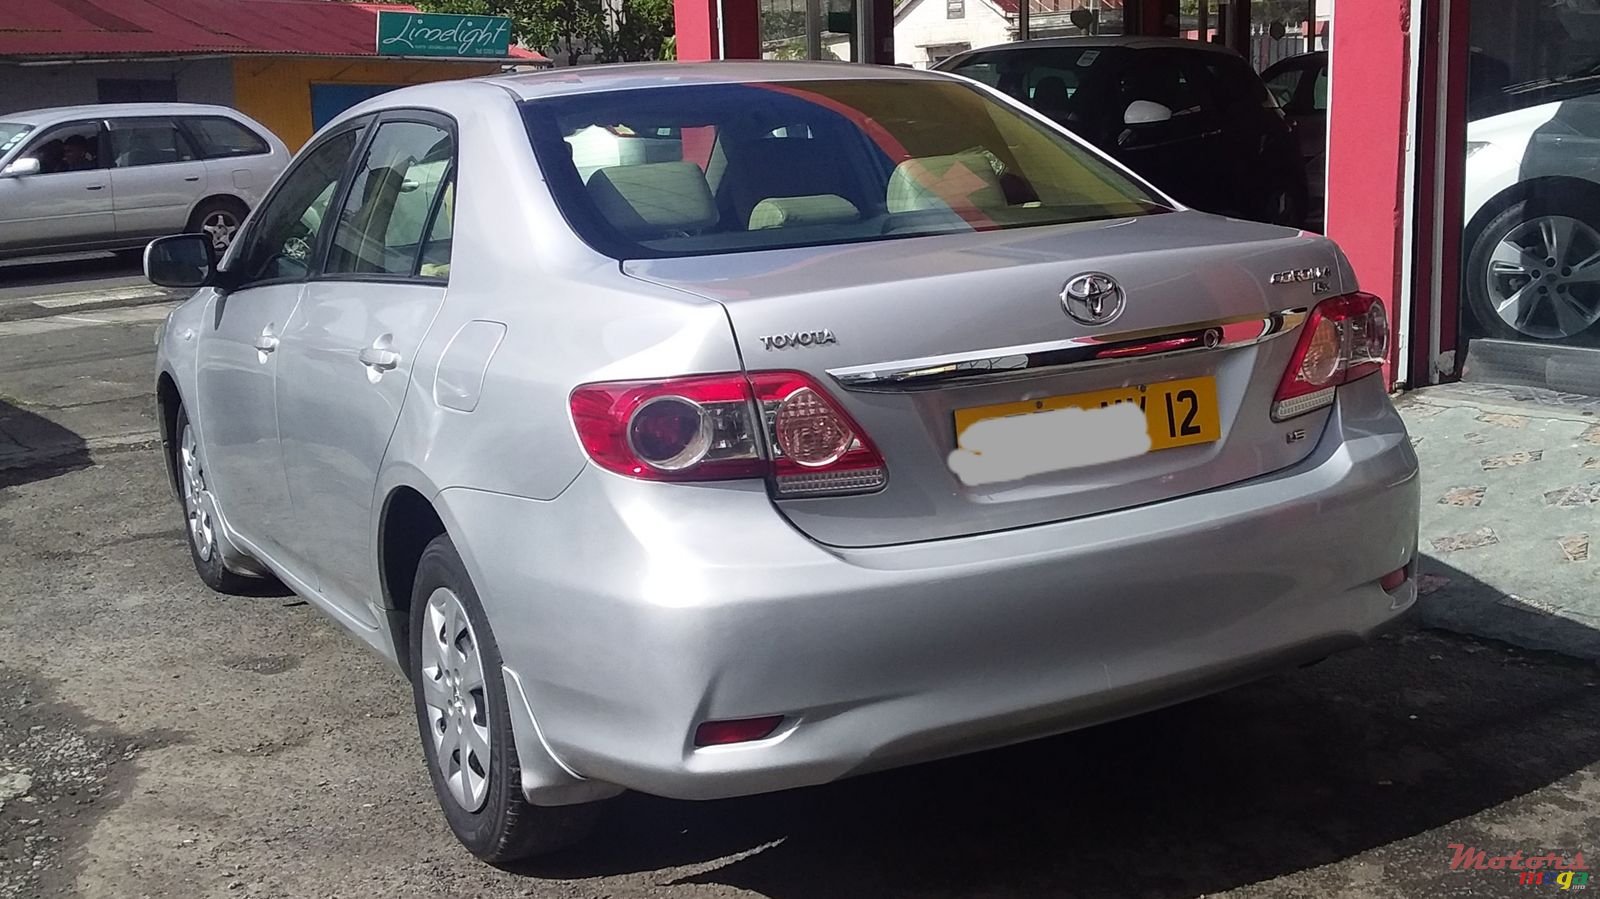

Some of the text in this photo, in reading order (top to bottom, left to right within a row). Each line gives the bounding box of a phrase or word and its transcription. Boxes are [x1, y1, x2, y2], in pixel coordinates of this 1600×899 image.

[382, 15, 507, 55] Limelight
[760, 329, 837, 350] TOYOTA
[1165, 389, 1201, 438] 12
